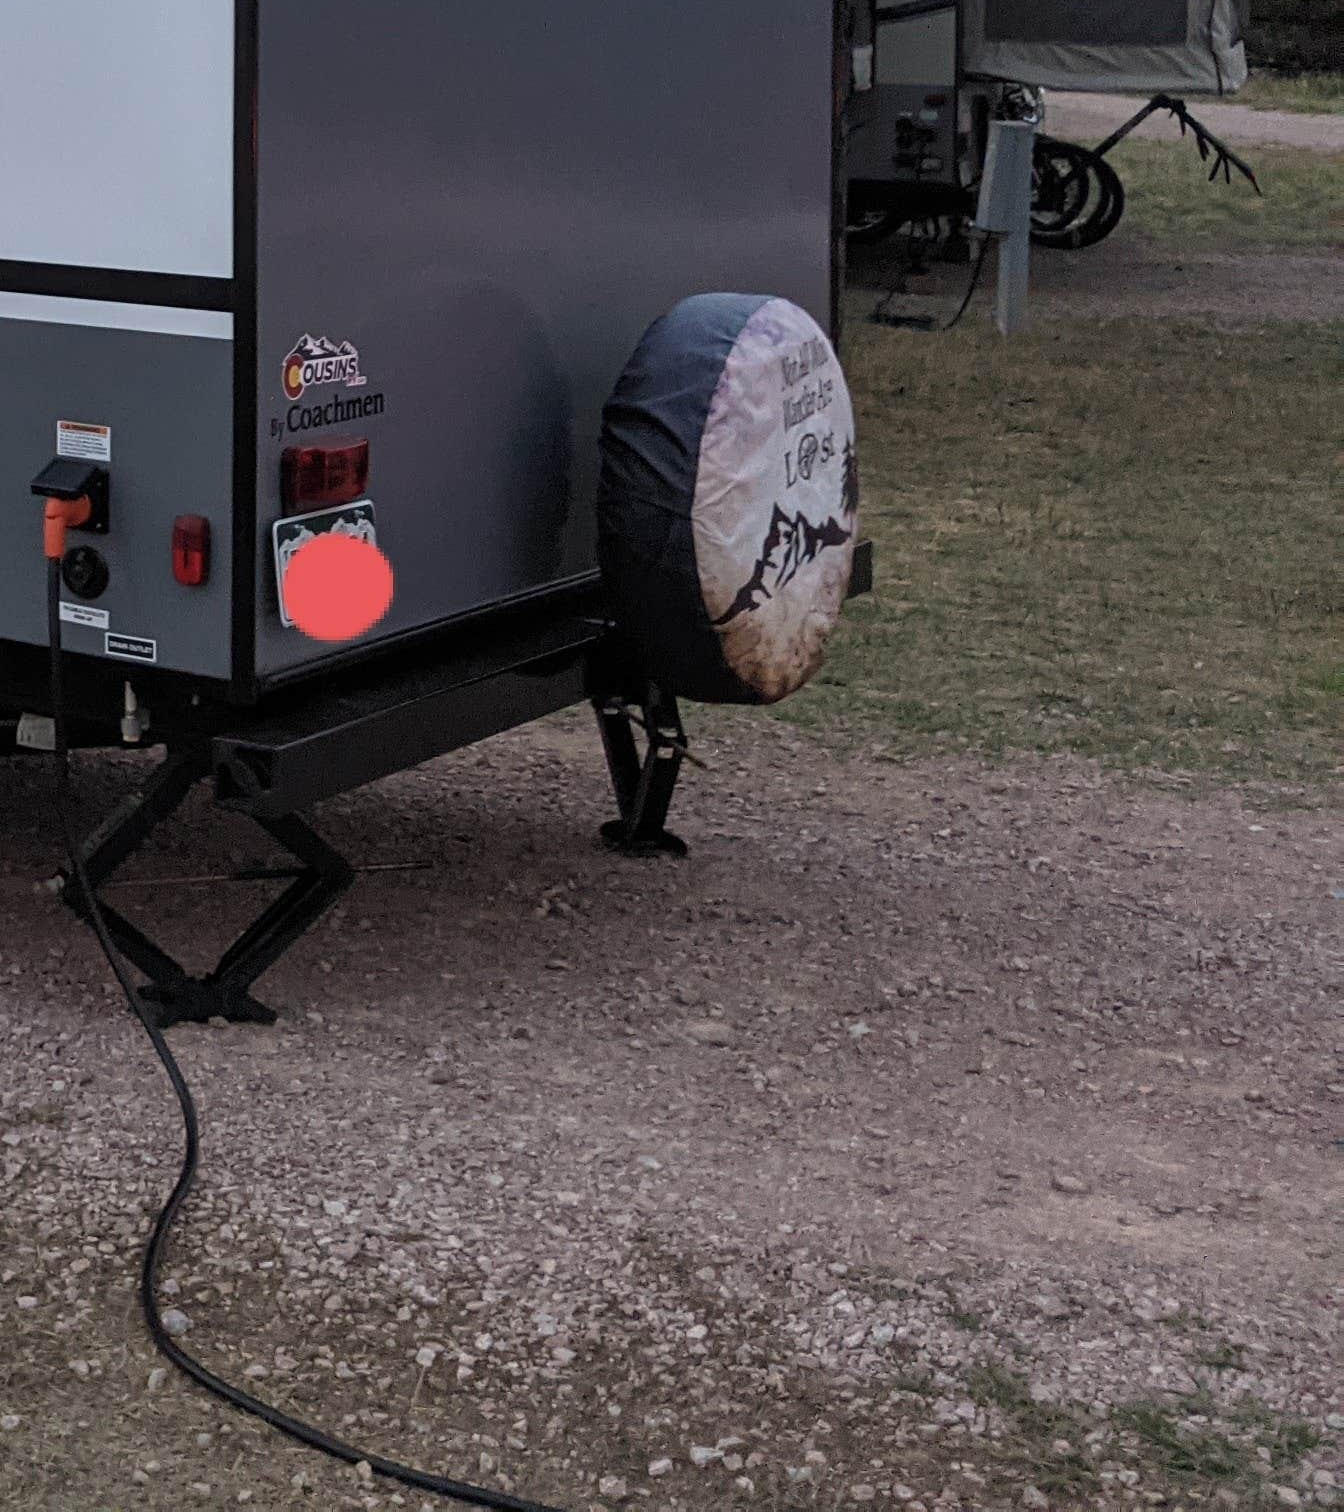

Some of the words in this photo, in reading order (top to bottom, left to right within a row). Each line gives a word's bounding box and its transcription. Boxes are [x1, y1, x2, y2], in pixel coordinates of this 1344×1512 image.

[284, 353, 357, 400] COUSINS
[270, 418, 285, 442] By
[287, 393, 385, 433] Coachmen
